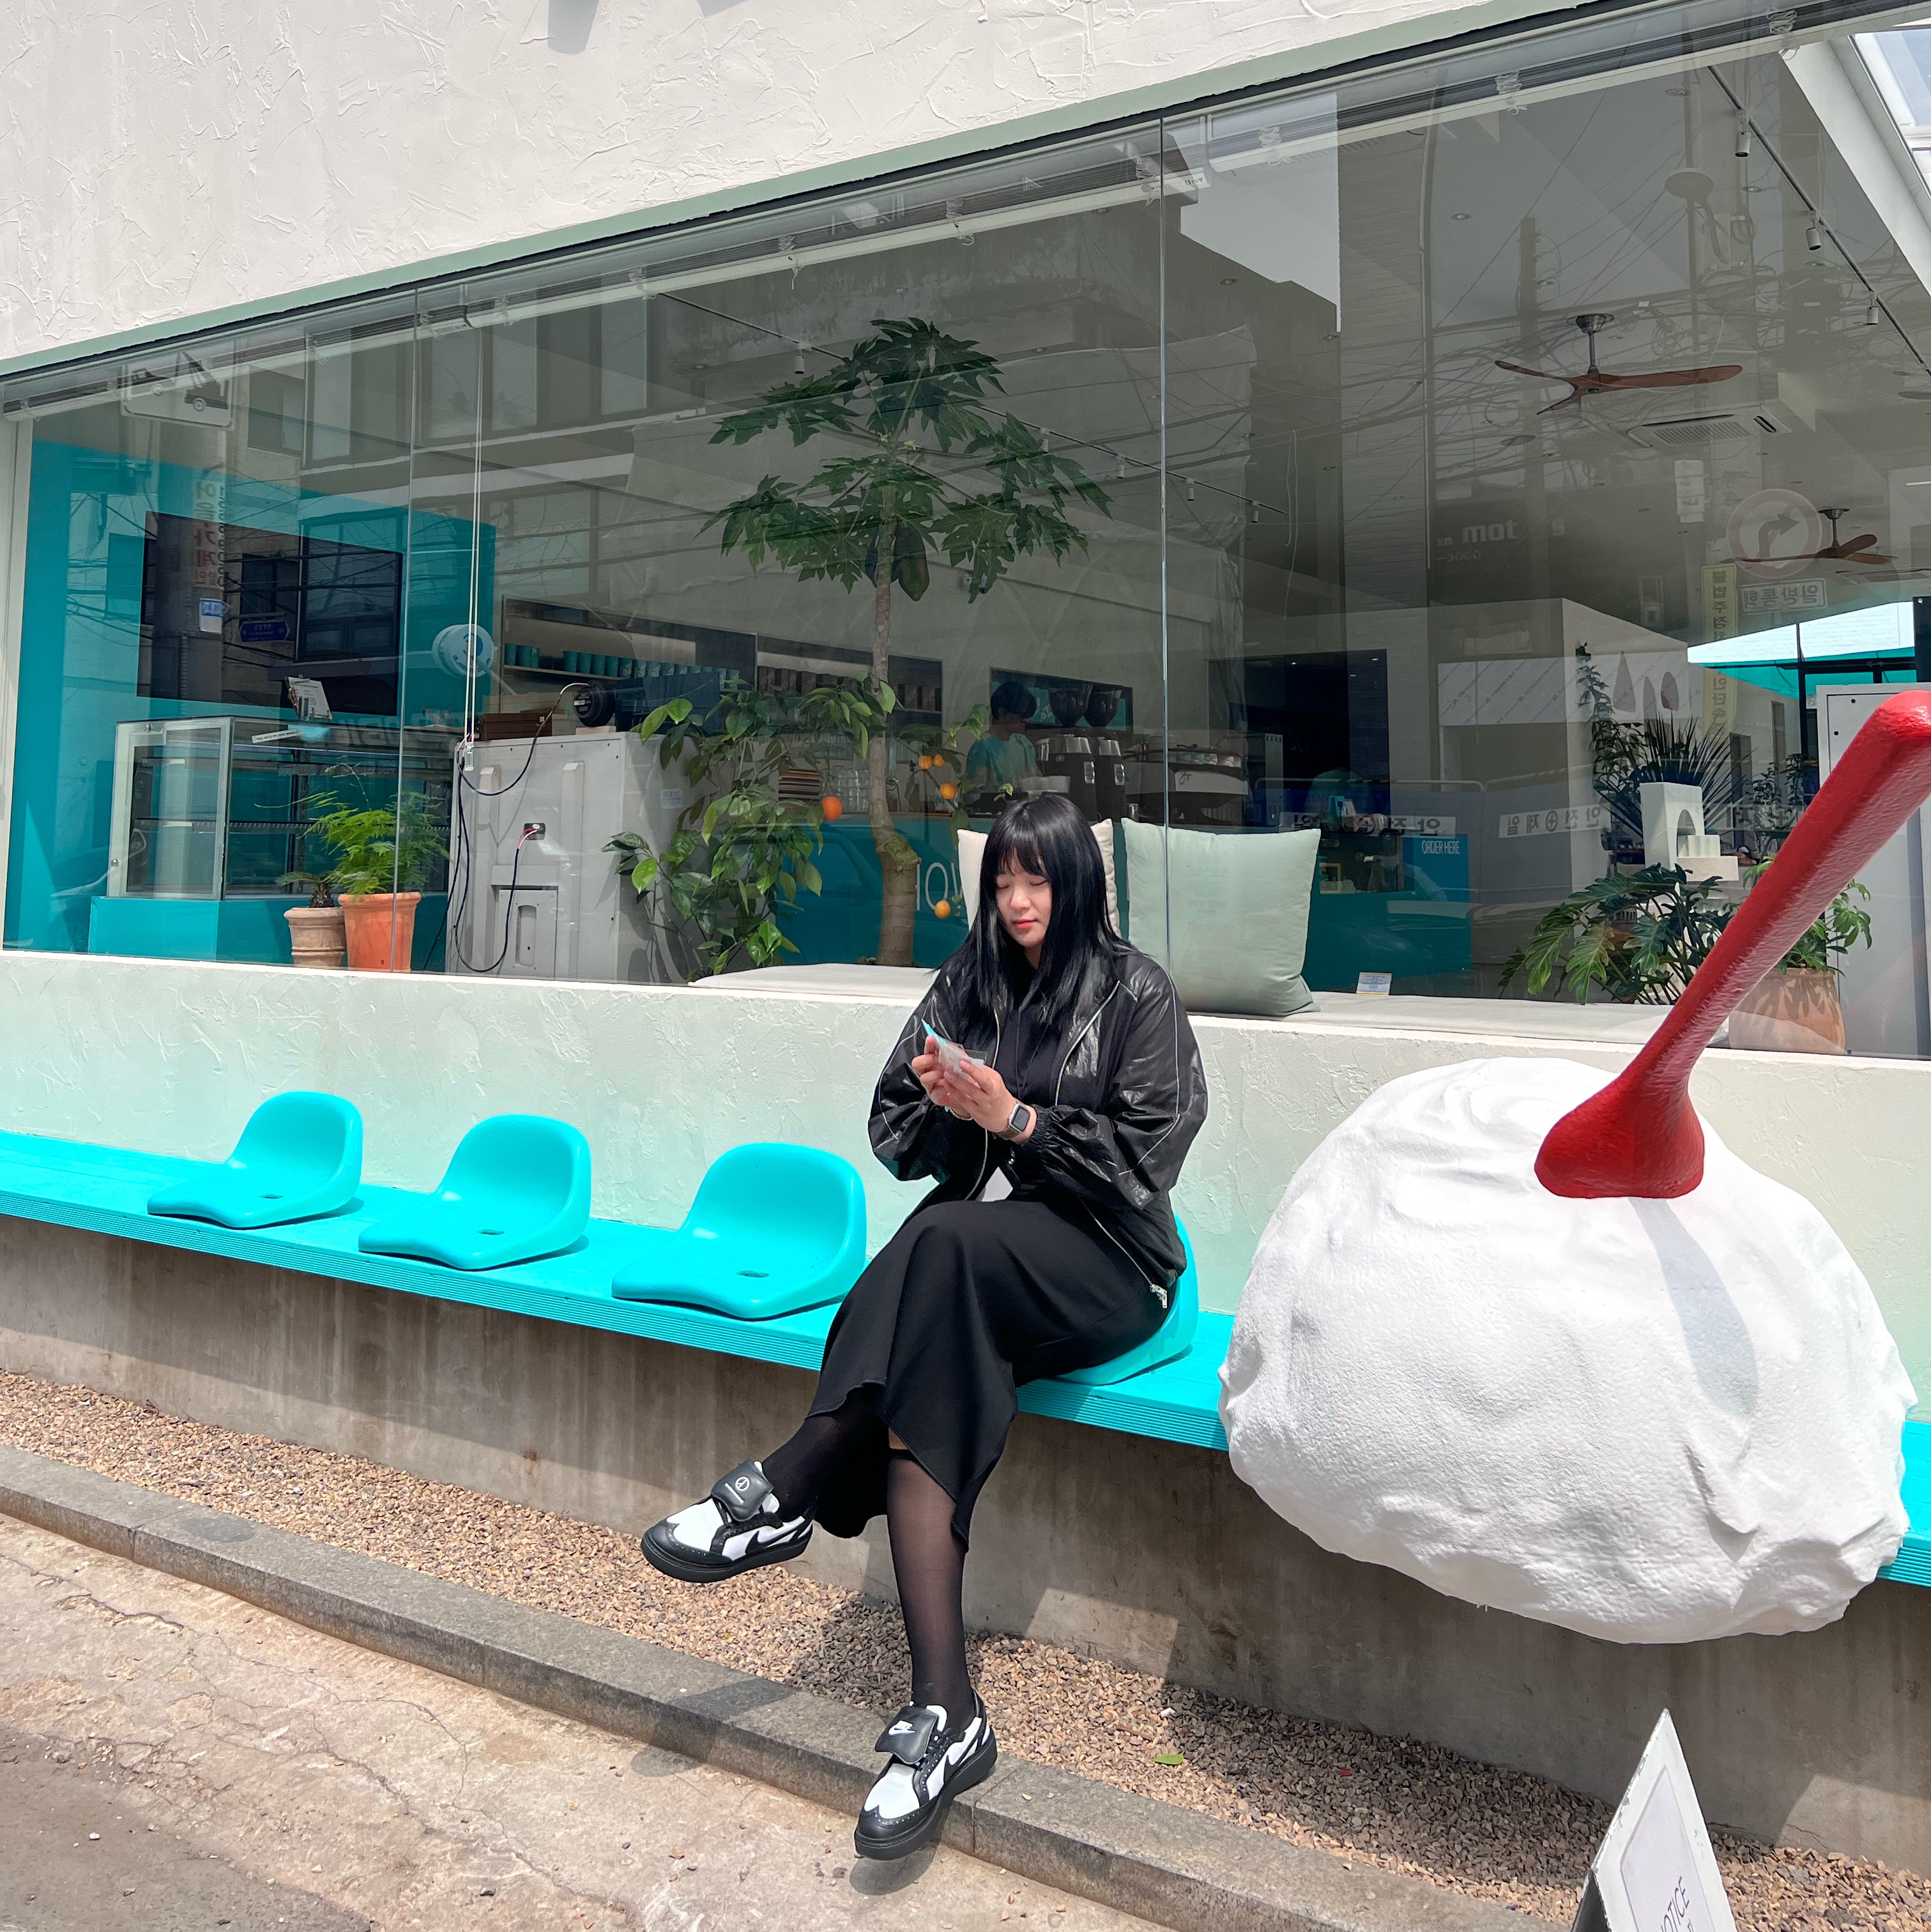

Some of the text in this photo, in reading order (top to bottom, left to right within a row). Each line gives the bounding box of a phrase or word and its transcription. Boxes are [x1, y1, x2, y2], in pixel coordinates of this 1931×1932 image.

[1421, 839, 1460, 855] ORDER HERE
[1661, 1875, 1690, 1932] OTICE
